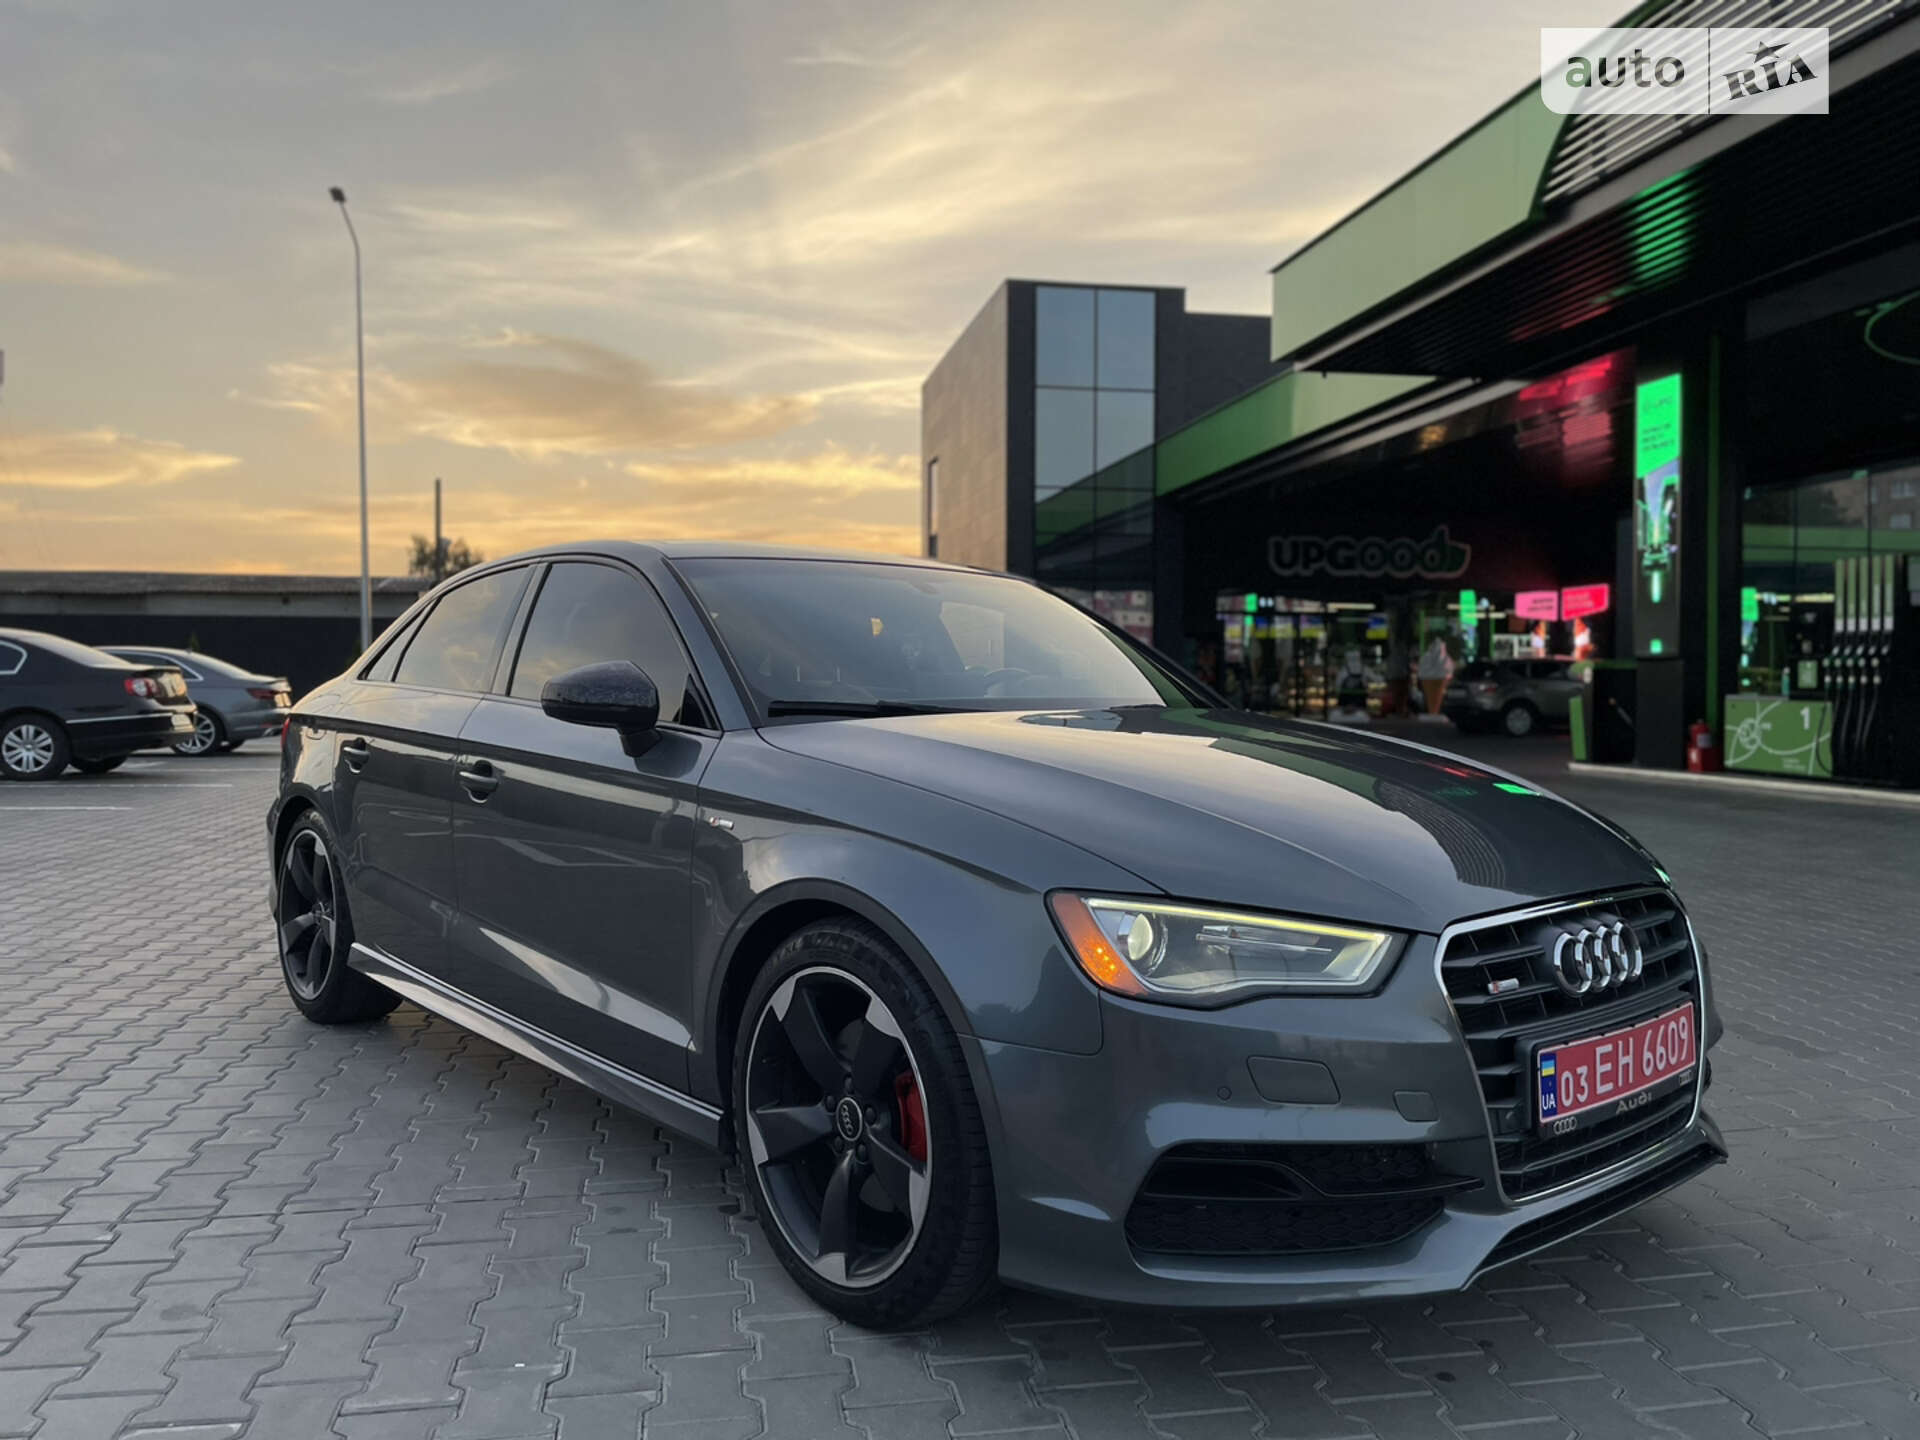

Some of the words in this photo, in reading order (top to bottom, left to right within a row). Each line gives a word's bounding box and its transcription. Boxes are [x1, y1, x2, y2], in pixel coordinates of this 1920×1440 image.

[1800, 706, 1811, 730] 1
[1561, 1066, 1588, 1107] 03
[1596, 1037, 1634, 1094] EH
[1643, 1016, 1688, 1076] 6609
[1542, 1093, 1557, 1110] UA
[1616, 1092, 1652, 1115] Audi
